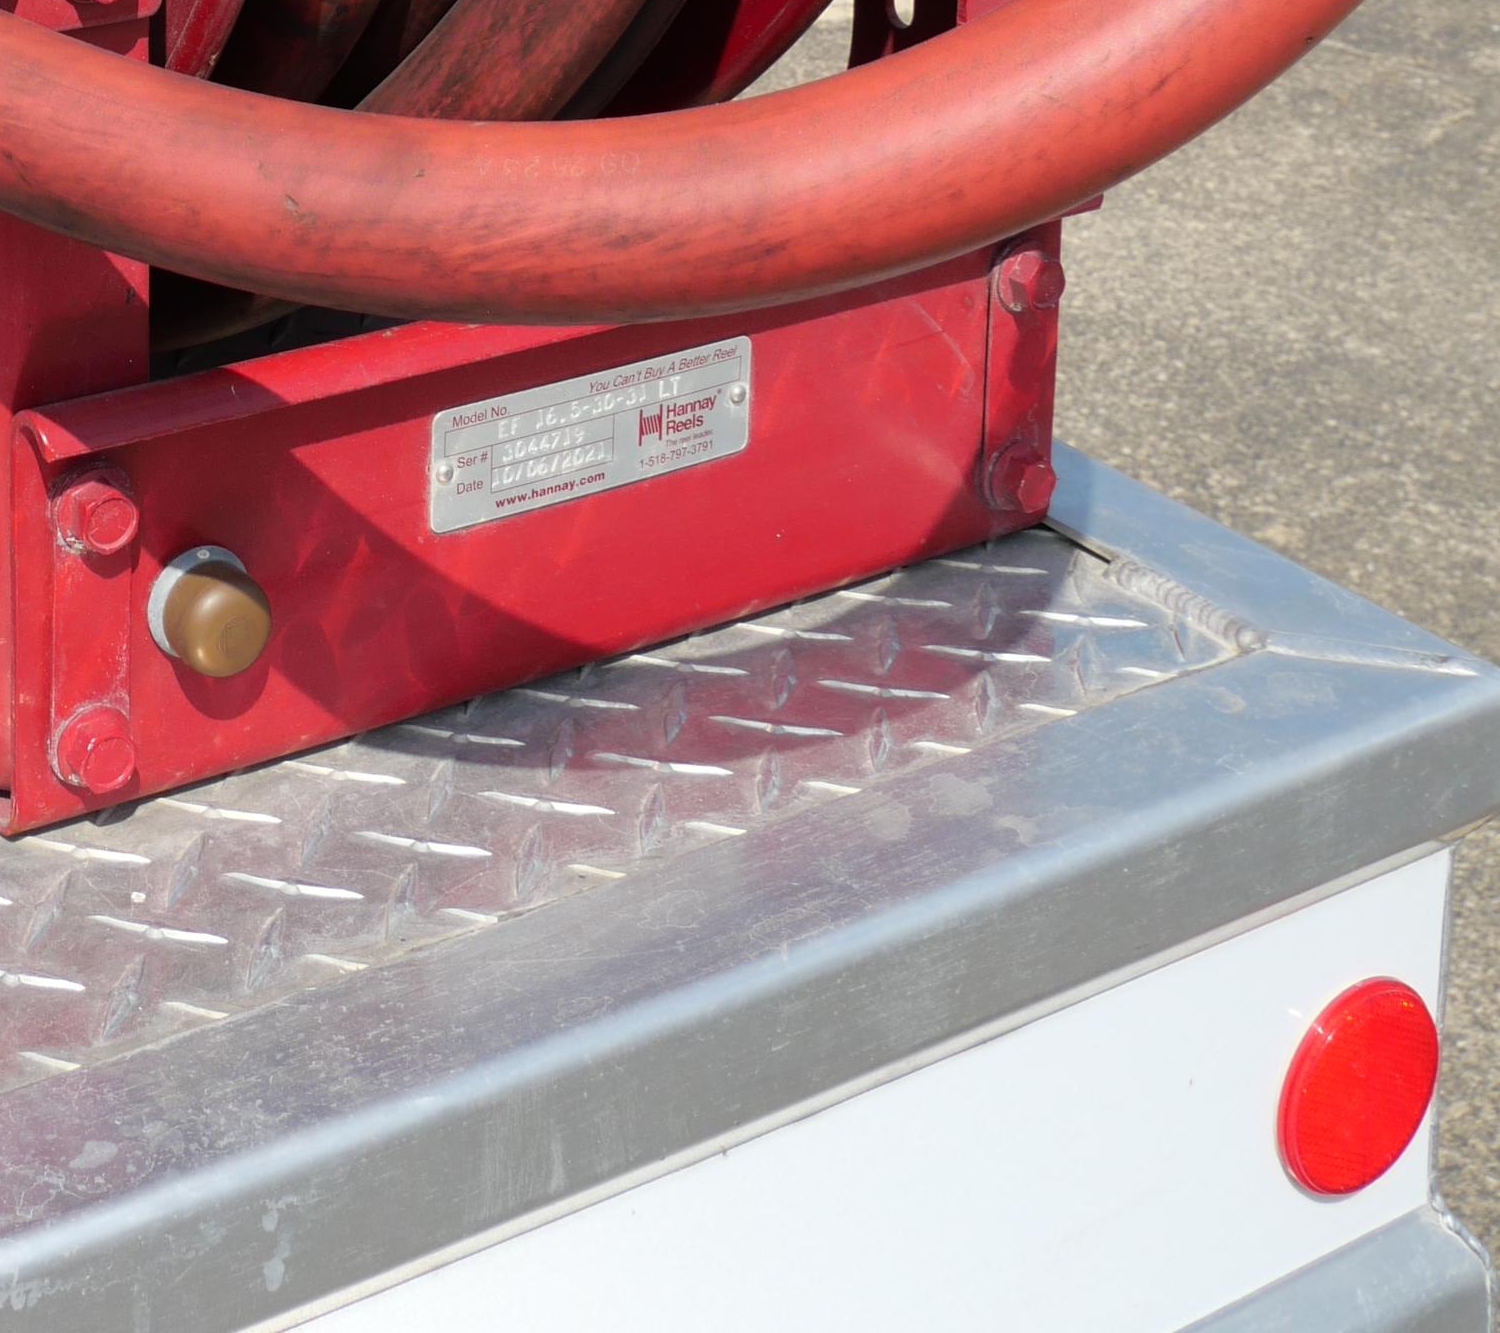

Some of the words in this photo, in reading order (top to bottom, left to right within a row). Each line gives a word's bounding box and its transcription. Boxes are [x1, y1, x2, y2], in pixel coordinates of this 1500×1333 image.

[588, 381, 610, 394] You
[613, 369, 642, 388] Can't
[643, 366, 666, 381] Buy
[666, 361, 676, 372] A
[678, 354, 711, 370] Better
[712, 345, 738, 361] Reel
[452, 411, 488, 429] Model
[497, 418, 521, 439] EF
[658, 376, 681, 400] LT
[666, 394, 717, 420] Hannay
[666, 414, 704, 436] Reels
[457, 455, 477, 469] Ser
[480, 451, 489, 463] #
[639, 440, 714, 469] 1-518-797-3791
[456, 479, 484, 495] Date
[495, 471, 606, 508] www.hannay.com
